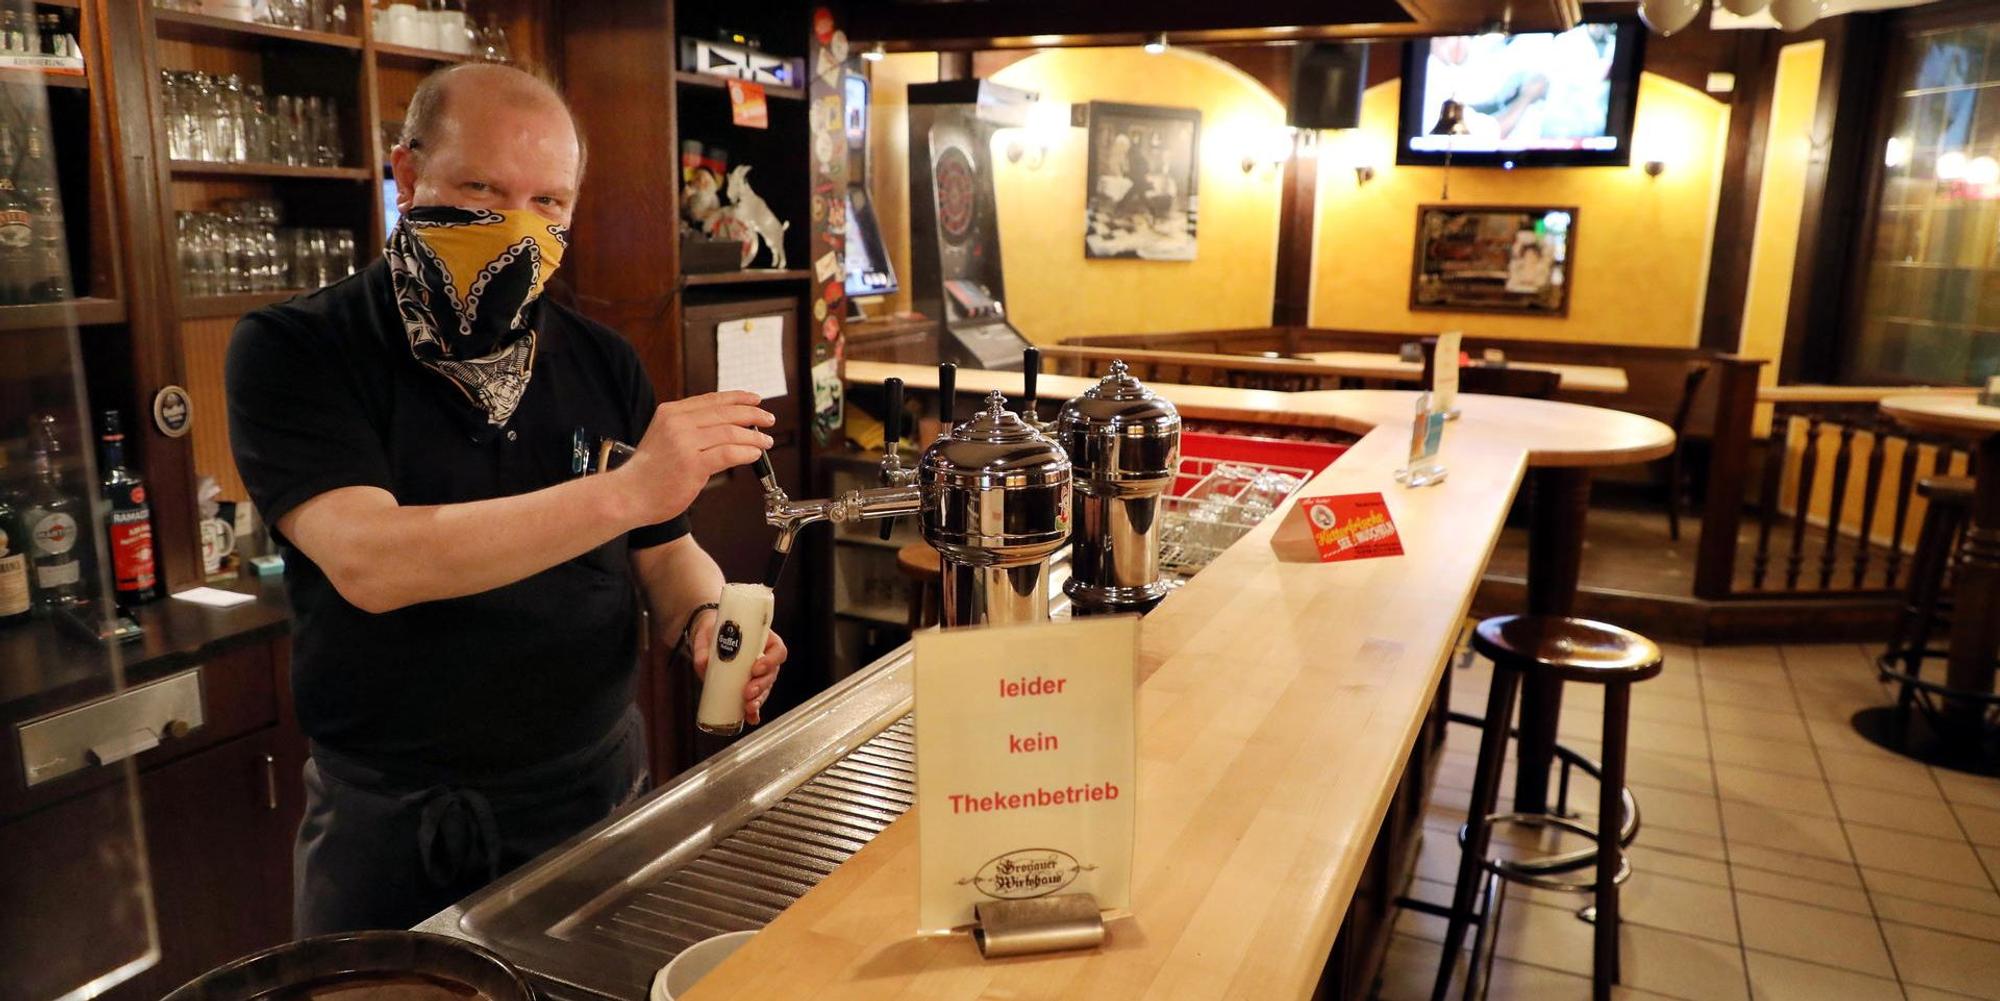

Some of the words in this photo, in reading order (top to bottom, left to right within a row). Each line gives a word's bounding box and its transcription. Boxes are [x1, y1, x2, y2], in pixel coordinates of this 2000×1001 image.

[1000, 676, 1066, 698] leider
[1009, 732, 1059, 754] kein
[948, 781, 1119, 814] Thekenbetrieb
